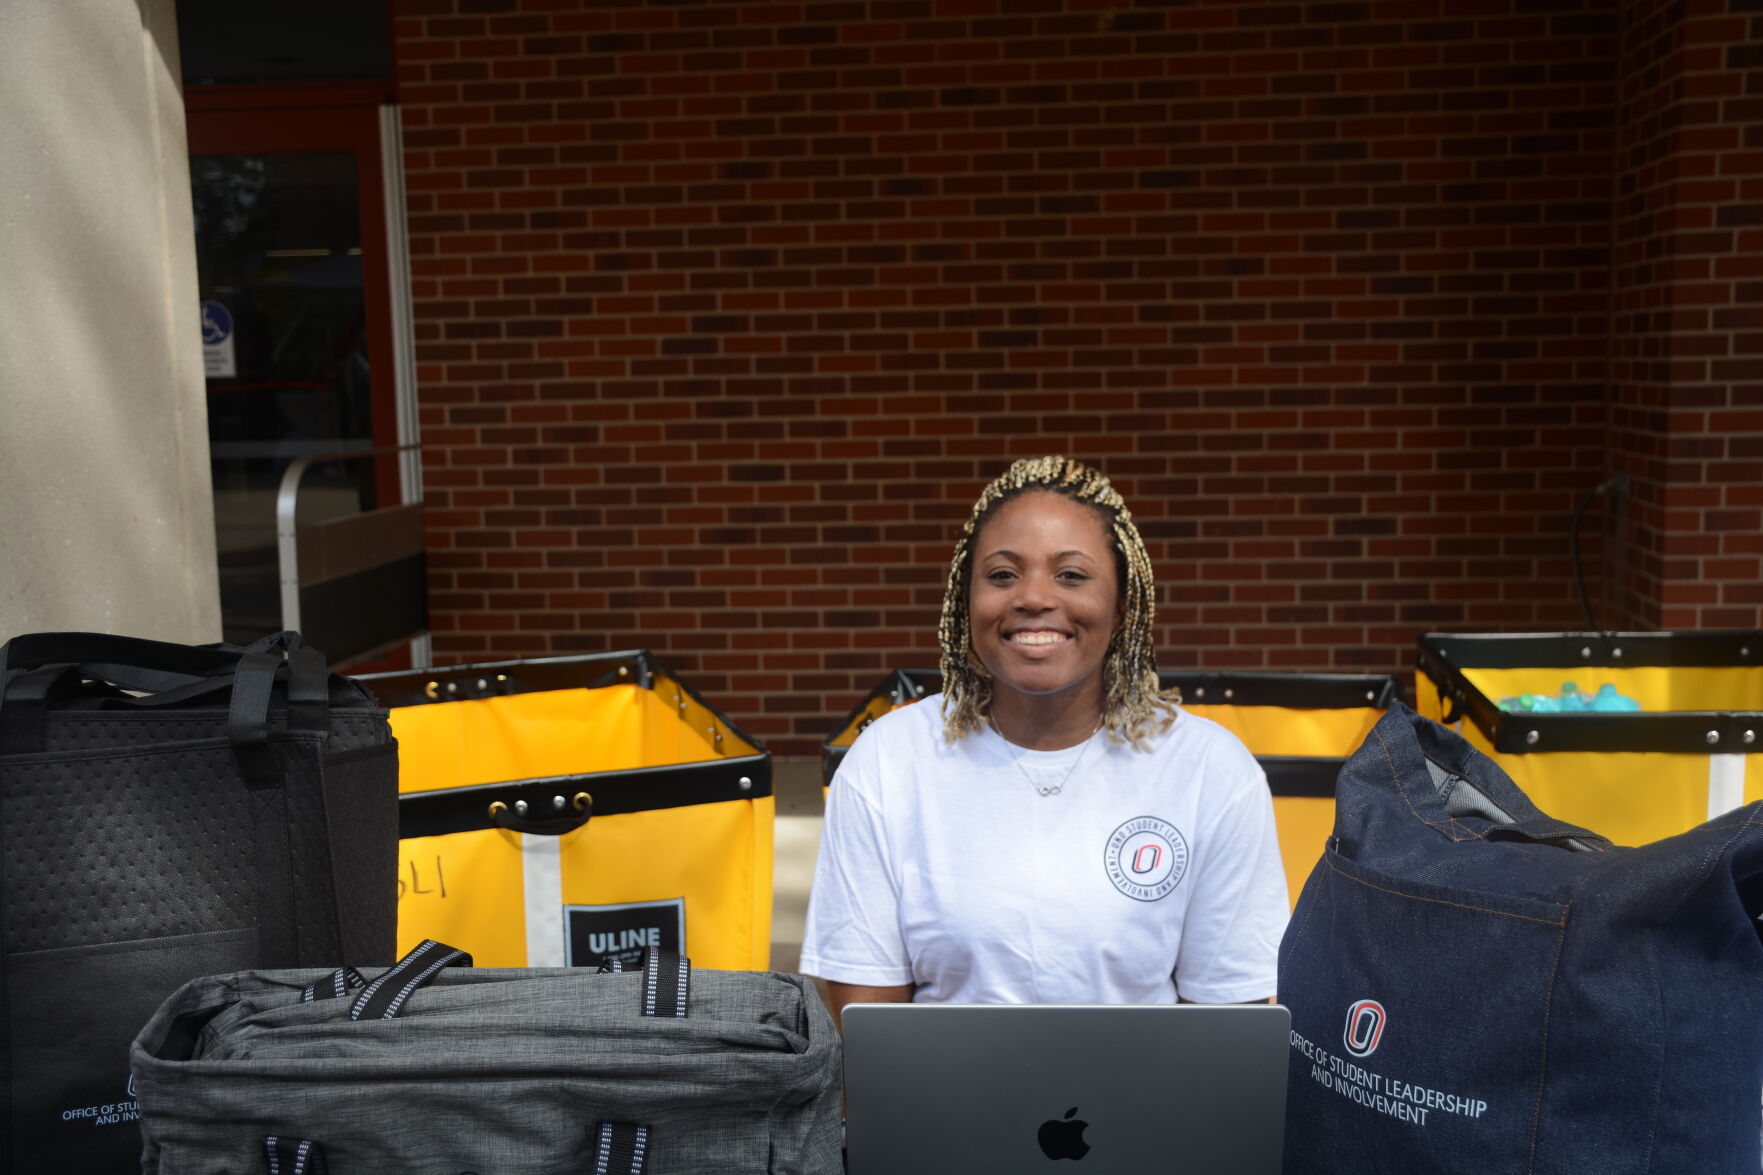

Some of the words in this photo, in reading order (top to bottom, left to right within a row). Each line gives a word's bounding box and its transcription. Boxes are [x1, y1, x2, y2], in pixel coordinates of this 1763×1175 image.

[1126, 820, 1164, 834] STUDENT
[1111, 831, 1127, 850] UNO
[1164, 828, 1185, 881] LEADERSHIP
[1108, 855, 1154, 898] INVOLVEMENT
[1155, 880, 1172, 896] AND
[588, 926, 661, 955] ULINE
[1290, 1029, 1315, 1060] OFFICE
[1315, 1047, 1328, 1067] OF
[1329, 1055, 1382, 1092] STUDENT
[1385, 1077, 1488, 1119] LEADERSHIP
[1311, 1063, 1333, 1088] AND
[1334, 1076, 1430, 1127] INVOLVEMENT
[62, 1106, 98, 1120] OFFICE
[100, 1103, 115, 1115] OF
[117, 1100, 140, 1113] STU
[95, 1113, 120, 1127] AND
